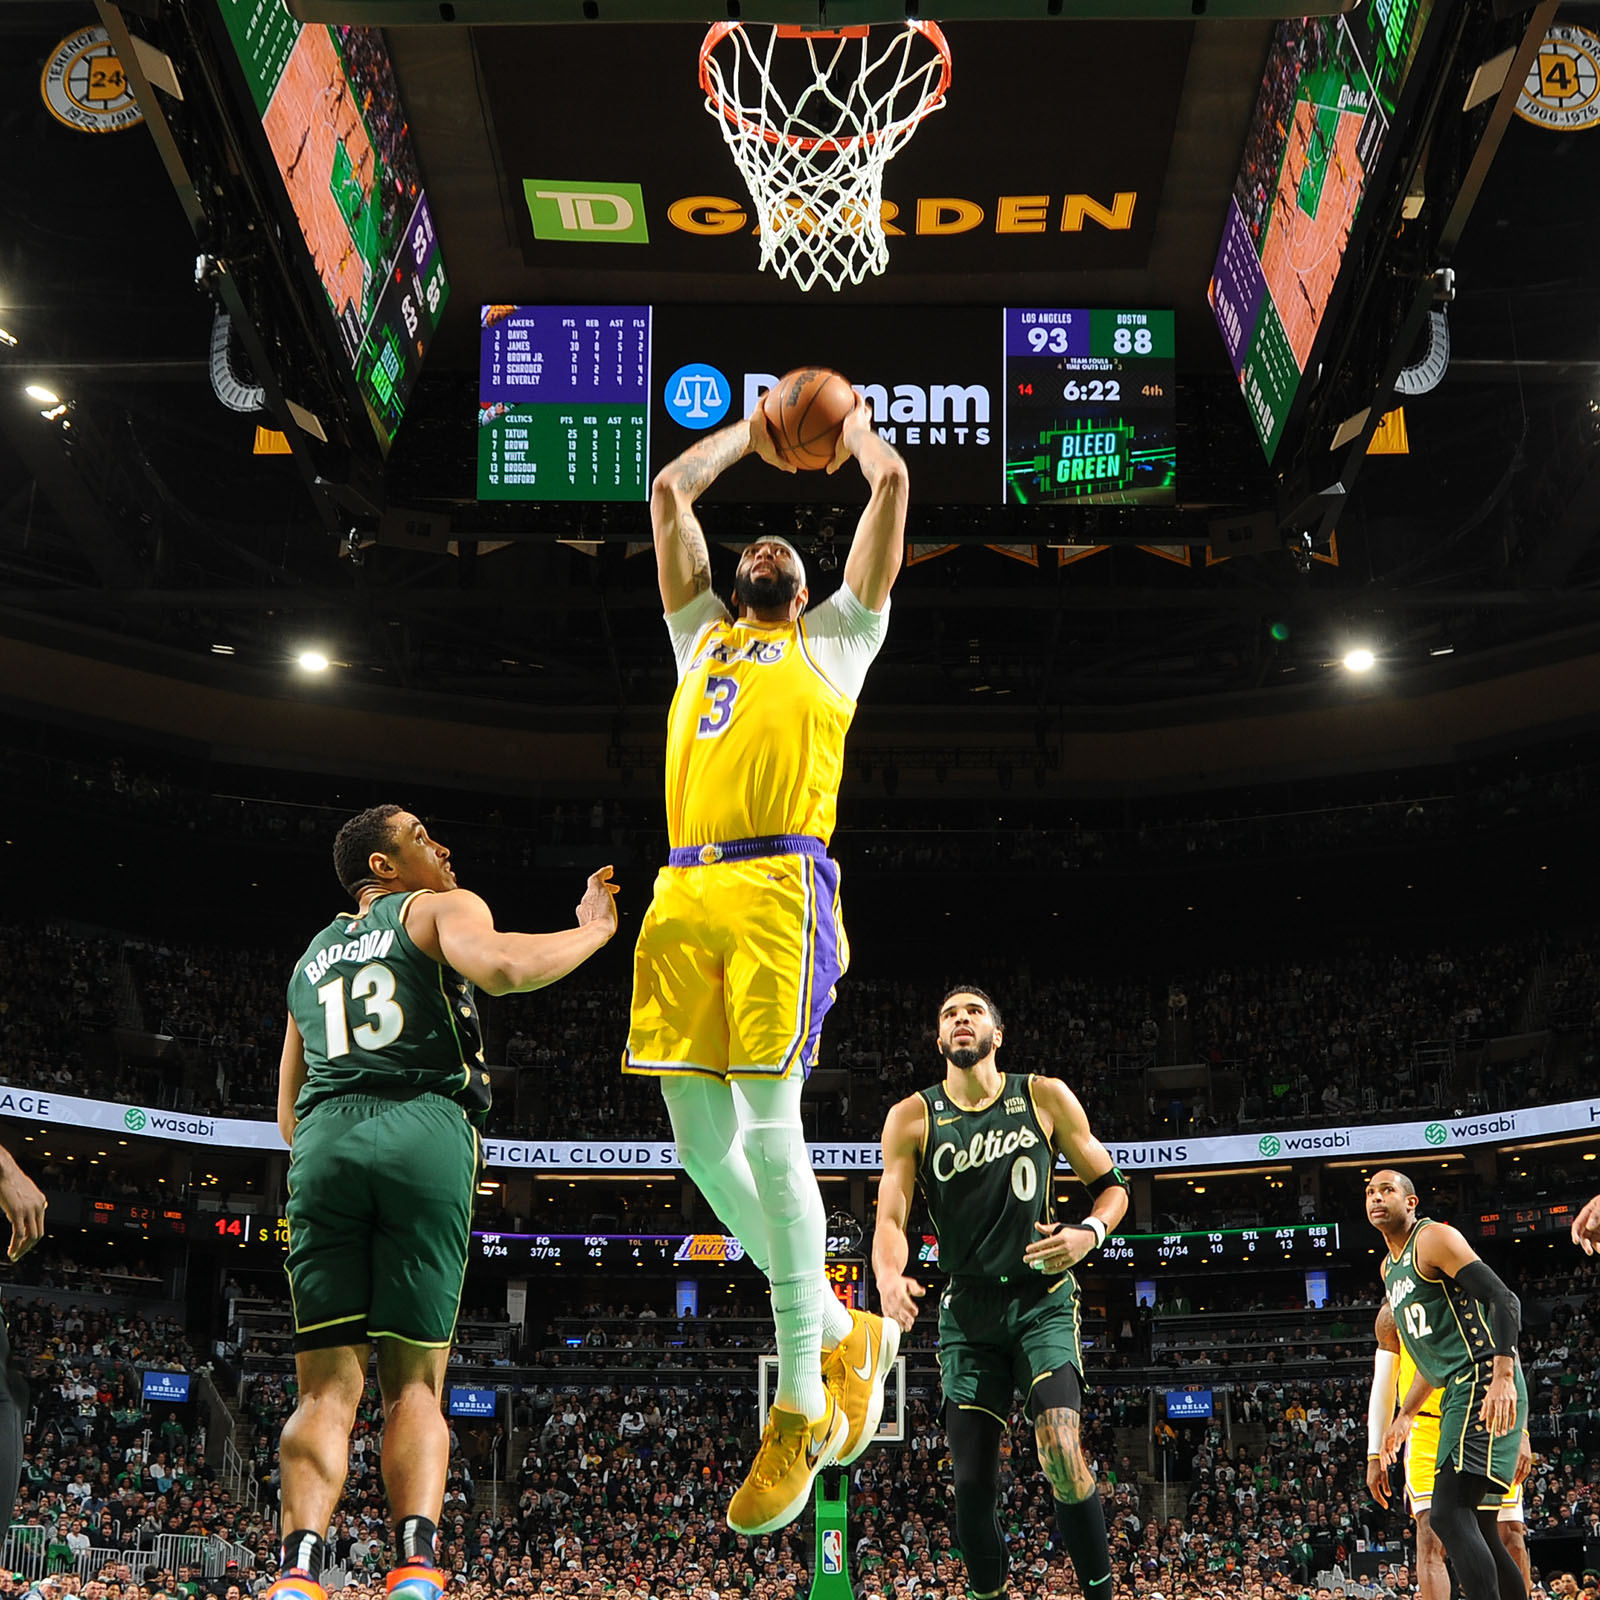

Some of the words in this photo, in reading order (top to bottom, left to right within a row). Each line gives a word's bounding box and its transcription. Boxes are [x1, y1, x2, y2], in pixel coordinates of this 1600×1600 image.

[92, 69, 124, 88] 24
[1546, 62, 1571, 90] 4
[535, 190, 634, 231] TD
[667, 192, 1137, 235] GARDEN
[507, 319, 535, 328] LAKERS
[562, 319, 576, 328] PTS
[585, 319, 600, 328] REB
[609, 319, 624, 328] AST
[632, 319, 646, 328] FLS
[1021, 312, 1036, 324] LOS
[1038, 312, 1072, 325] ANGELES
[1116, 313, 1147, 325] BOSTON
[494, 330, 501, 340] 3
[507, 329, 528, 340] DAVIS
[570, 330, 579, 340] 11
[594, 330, 601, 340] 7
[617, 330, 624, 340] 3
[638, 330, 645, 340] 3
[1027, 327, 1068, 353] 93
[1113, 328, 1153, 355] 88
[494, 342, 501, 352] 6
[506, 340, 530, 352] JAMES
[569, 342, 581, 352] 30
[594, 342, 601, 352] 8
[617, 342, 624, 352] 5
[638, 342, 645, 352] 2
[494, 352, 501, 362] 7
[506, 352, 532, 362] BROWN
[571, 352, 578, 362] 2
[594, 352, 601, 362] 4
[617, 352, 623, 362] 1
[638, 352, 644, 362] 1
[492, 364, 501, 374] 17
[506, 363, 542, 374] SCHRODER
[571, 364, 578, 374] 11
[593, 364, 600, 374] 2
[616, 364, 623, 374] 3
[637, 364, 644, 374] 4
[492, 374, 501, 386] 21
[506, 374, 540, 386] BEVERLEY
[571, 376, 578, 386] 9
[593, 376, 600, 386] 2
[616, 376, 623, 386] 4
[637, 376, 644, 386] 2
[1017, 383, 1033, 396] 14
[1063, 380, 1121, 401] 6:22
[1141, 384, 1163, 397] 4th
[743, 373, 990, 423] Pnam
[504, 414, 533, 423] CELTICS
[560, 416, 574, 425] PTS
[583, 416, 598, 425] REB
[607, 416, 622, 425] AST
[630, 416, 644, 425] FLS
[492, 428, 498, 438] 0
[504, 428, 528, 438] TATUM
[567, 428, 578, 438] 25
[592, 428, 599, 440] 9
[615, 430, 621, 440] 3
[635, 430, 642, 440] 2
[491, 440, 498, 450] 7
[504, 439, 530, 450] BROWN
[568, 440, 577, 450] 19
[592, 440, 598, 450] 5
[615, 440, 620, 450] 1
[635, 440, 642, 450] 5
[1062, 433, 1116, 458] BLEED
[491, 452, 498, 462] 9
[503, 451, 526, 462] WHITE
[568, 452, 577, 462] 14
[591, 452, 598, 462] 5
[615, 452, 620, 462] 1
[635, 452, 642, 462] 0
[490, 462, 498, 472] 13
[504, 462, 536, 472] BROGDON
[568, 462, 577, 474] 15
[591, 464, 598, 474] 4
[614, 464, 621, 474] 3
[636, 464, 641, 474] 1
[1056, 455, 1120, 483] GREEN
[488, 474, 499, 484] 42
[503, 474, 536, 484] HORFORD
[568, 474, 575, 484] 4
[592, 474, 597, 484] 1
[614, 474, 620, 484] 3
[636, 474, 641, 484] 1
[688, 637, 788, 671] LARS
[697, 674, 740, 740] 3
[304, 929, 395, 986] BROGDON
[317, 962, 404, 1060] 13
[934, 1101, 944, 1111] 6
[1003, 1096, 1025, 1108] VISTA
[1005, 1105, 1027, 1116] PRINT
[150, 1115, 215, 1137] wasabi
[481, 1145, 561, 1163] FICIAL
[569, 1147, 651, 1164] CLOUD
[1284, 1131, 1351, 1151] wasabi
[1451, 1114, 1516, 1138] wasabi
[932, 1126, 1039, 1182] Celtics
[1011, 1155, 1037, 1201] 0
[215, 1219, 241, 1236] 14
[482, 1234, 501, 1244] 3PT
[536, 1237, 550, 1246] FG
[584, 1236, 608, 1246] FG%
[654, 1239, 669, 1247] FLS
[1111, 1238, 1126, 1247] FG
[1163, 1235, 1182, 1245] 3PT
[1207, 1233, 1223, 1243] TO
[1242, 1231, 1259, 1240] STL
[1275, 1228, 1295, 1238] AST
[1308, 1226, 1328, 1237] REB
[482, 1245, 508, 1258] 9/34
[530, 1248, 561, 1260] 37/82
[588, 1248, 602, 1258] 45
[632, 1248, 640, 1257] 4
[659, 1248, 666, 1258] 1
[680, 1239, 740, 1260] LAKERS
[1103, 1248, 1134, 1260] 28/66
[1157, 1246, 1188, 1258] 10/34
[1210, 1243, 1224, 1254] 10
[1248, 1241, 1256, 1251] 6
[1279, 1239, 1293, 1250] 13
[1313, 1237, 1327, 1248] 36
[1404, 1302, 1433, 1340] 42
